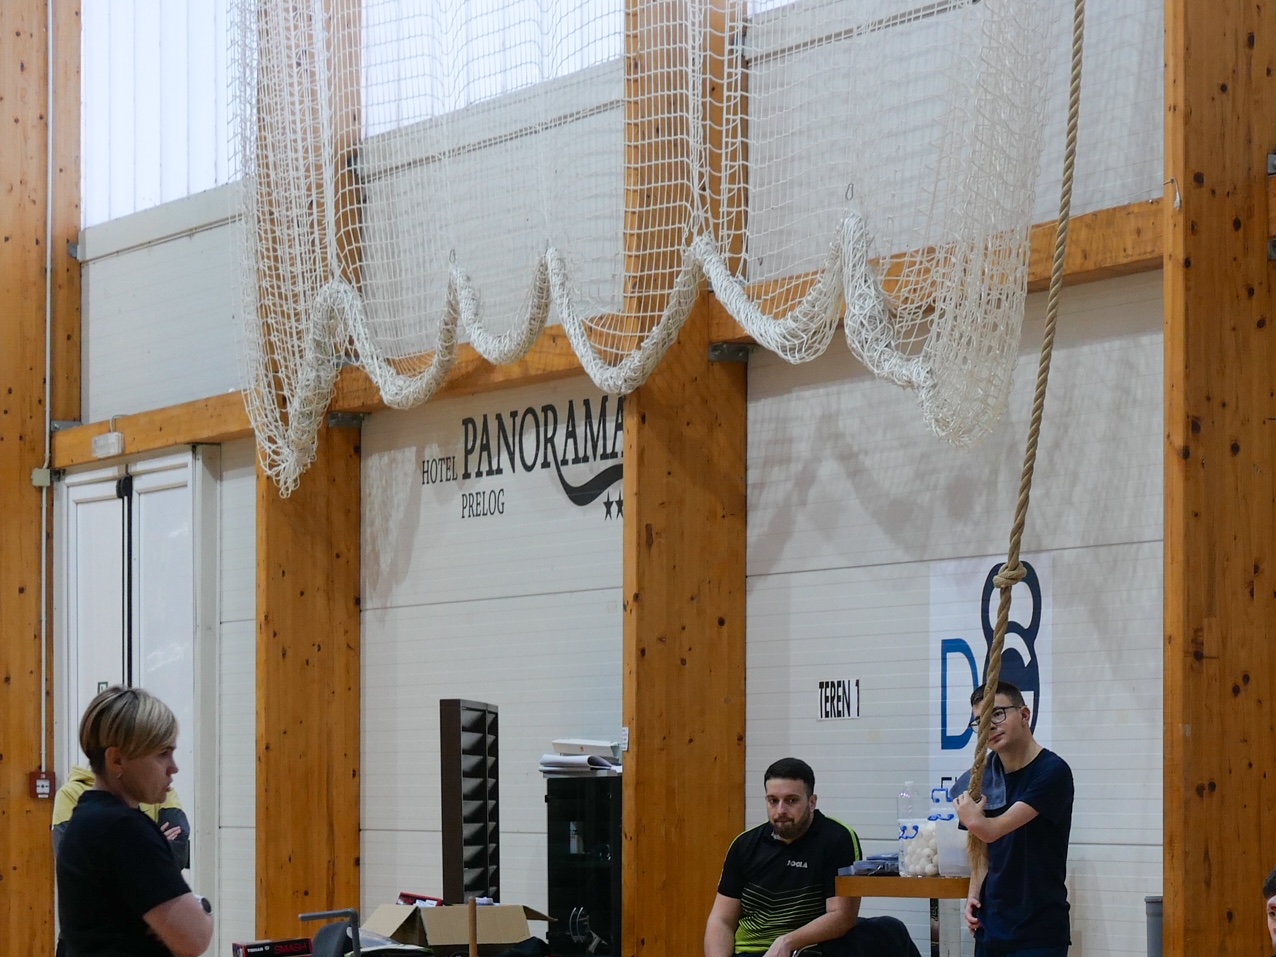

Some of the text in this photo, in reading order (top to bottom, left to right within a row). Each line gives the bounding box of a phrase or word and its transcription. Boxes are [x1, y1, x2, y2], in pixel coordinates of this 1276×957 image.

[422, 456, 457, 485] HOTEL
[461, 489, 505, 518] PRELOG
[819, 679, 860, 719] TEREN 1
[275, 943, 307, 954] SMASH
